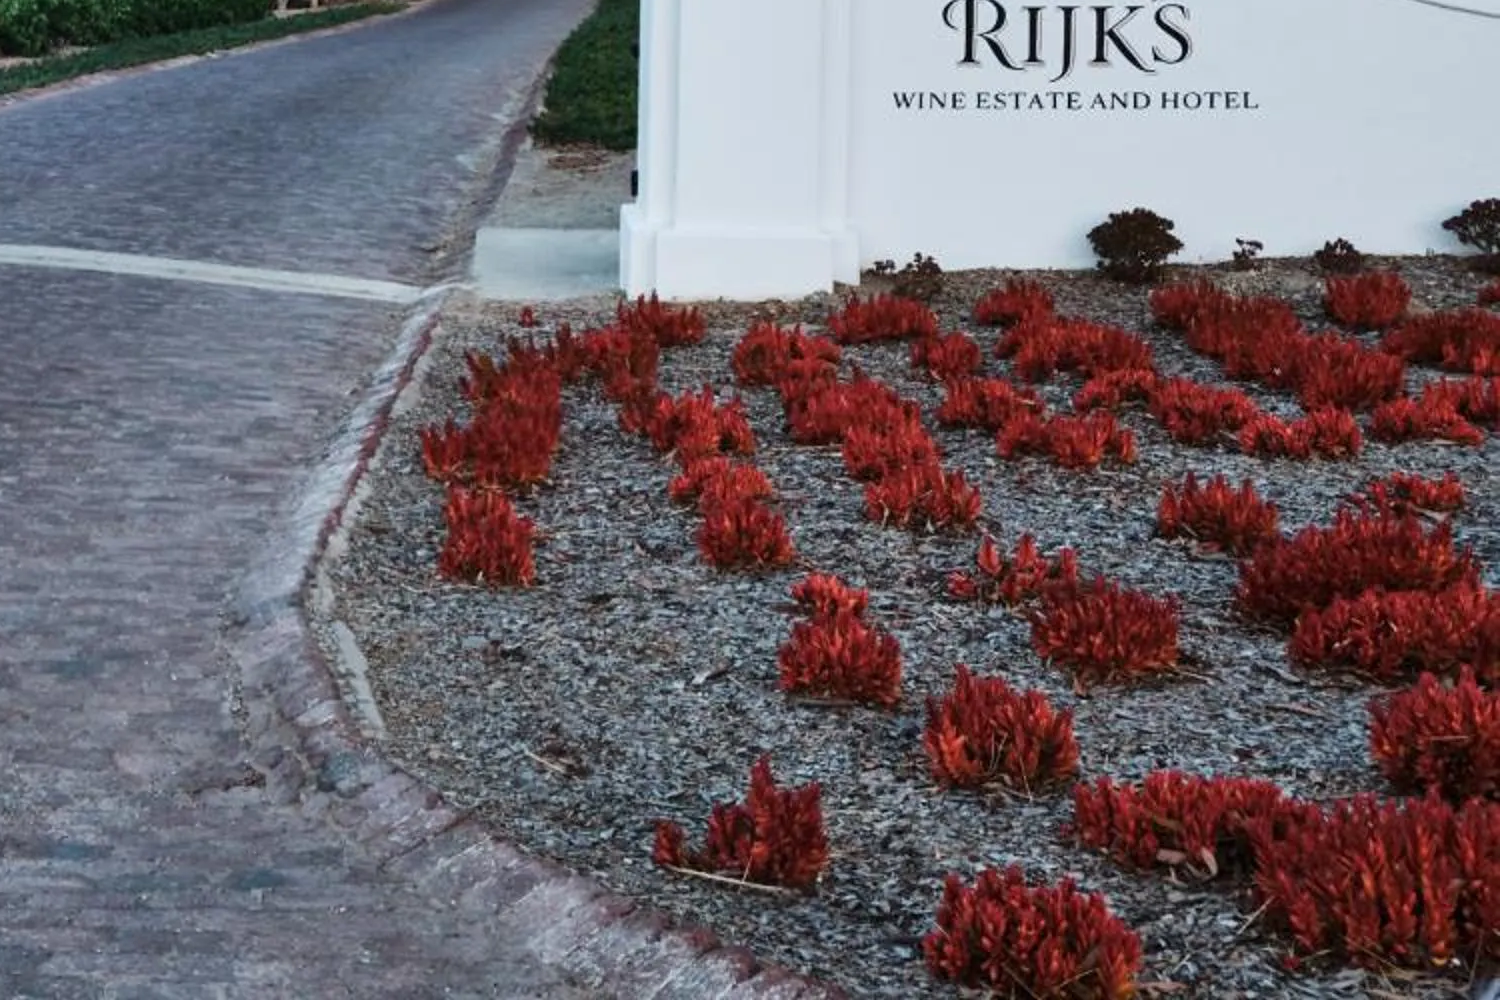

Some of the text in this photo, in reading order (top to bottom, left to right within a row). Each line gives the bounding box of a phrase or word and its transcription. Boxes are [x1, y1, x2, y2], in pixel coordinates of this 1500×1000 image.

[893, 91, 1259, 109] WINE ESTATE AND HOTEL
